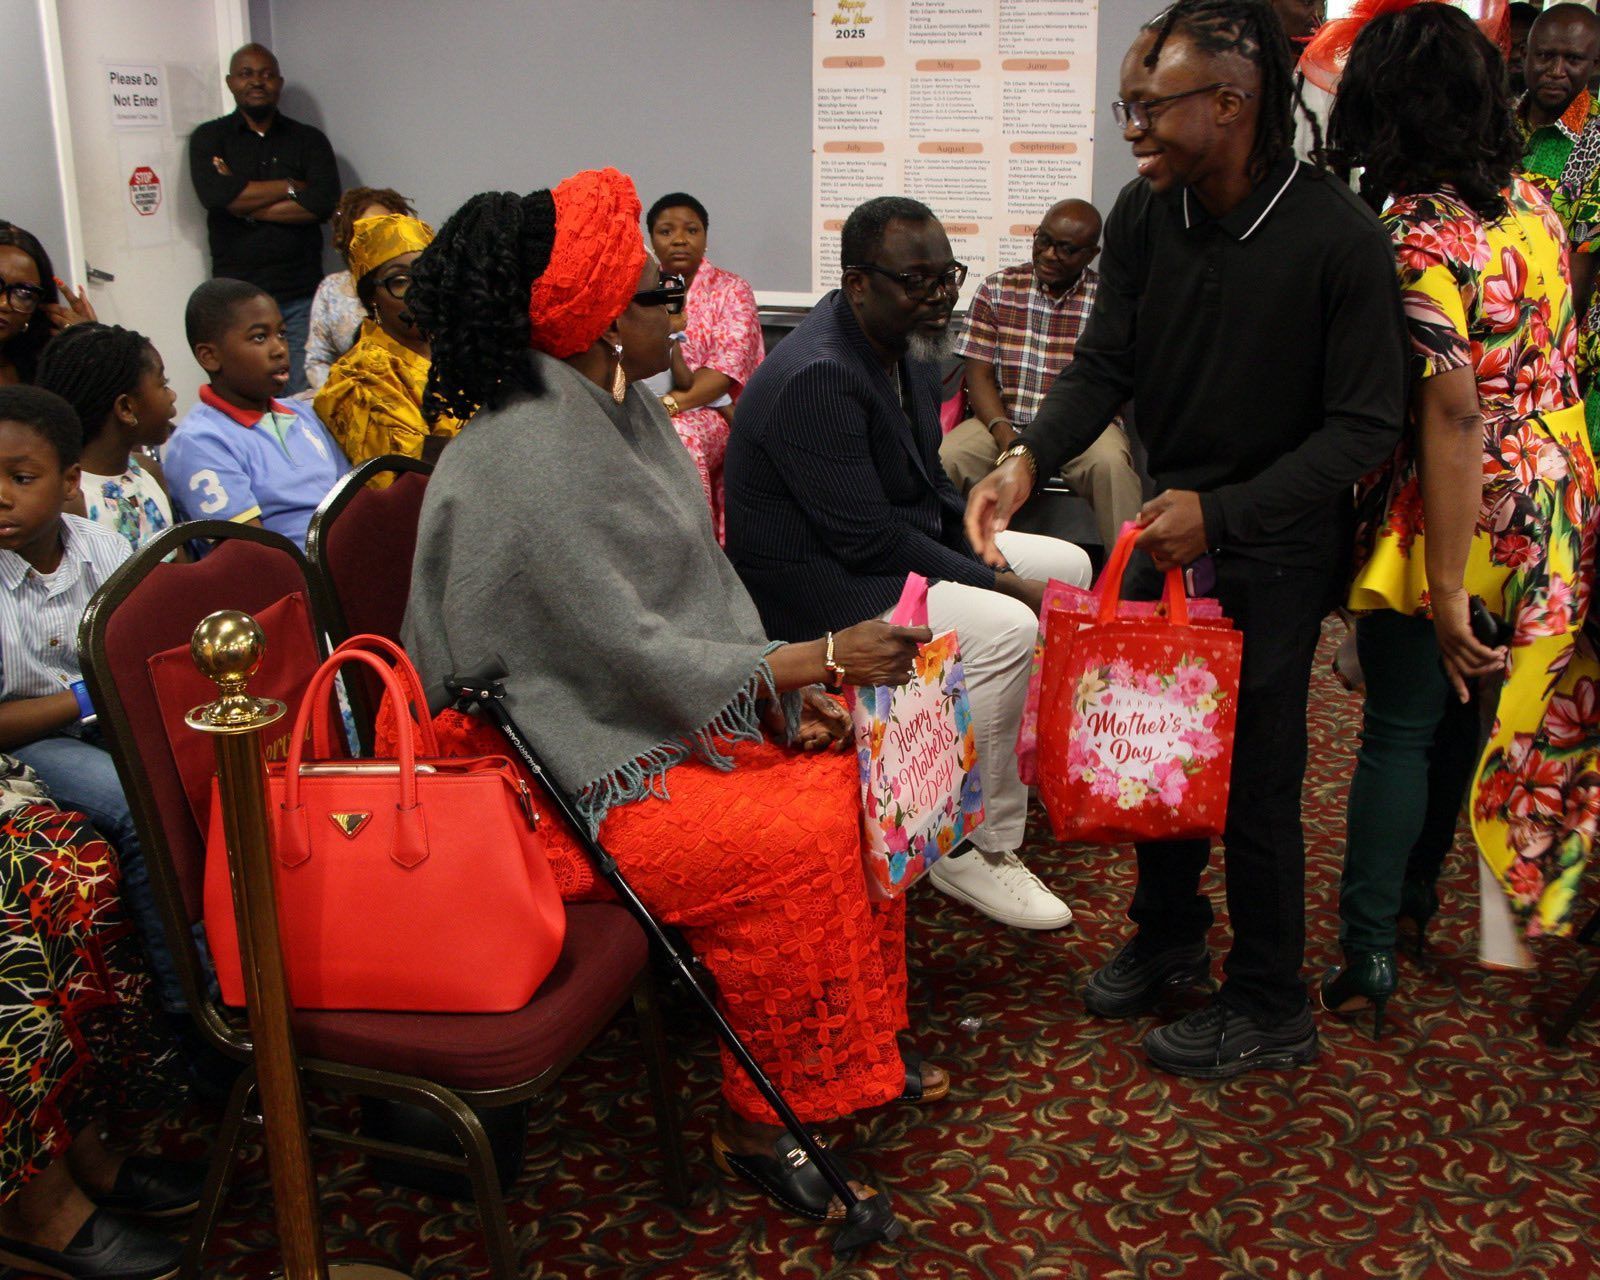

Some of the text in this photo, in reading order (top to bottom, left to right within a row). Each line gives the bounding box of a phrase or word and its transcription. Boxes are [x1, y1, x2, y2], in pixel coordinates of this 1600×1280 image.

[836, 29, 866, 39] 2025
[845, 59, 863, 68] April
[937, 60, 955, 70] May
[1026, 62, 1048, 71] June
[109, 71, 158, 87] Please Do
[113, 93, 158, 108] Not Enter
[847, 144, 862, 152] July
[937, 146, 965, 154] August
[1021, 143, 1066, 152] September
[134, 171, 153, 185] STOP
[820, 174, 854, 182] Independence
[1008, 208, 1045, 216] Family Special
[189, 468, 229, 514] 3
[1116, 699, 1163, 711] HAPPY
[1086, 710, 1183, 738] Mother's
[889, 708, 933, 764] Happy
[502, 724, 537, 768] HURRYCANE
[1109, 738, 1162, 765] Day
[899, 720, 954, 802] Mother's
[919, 755, 954, 811] Day
